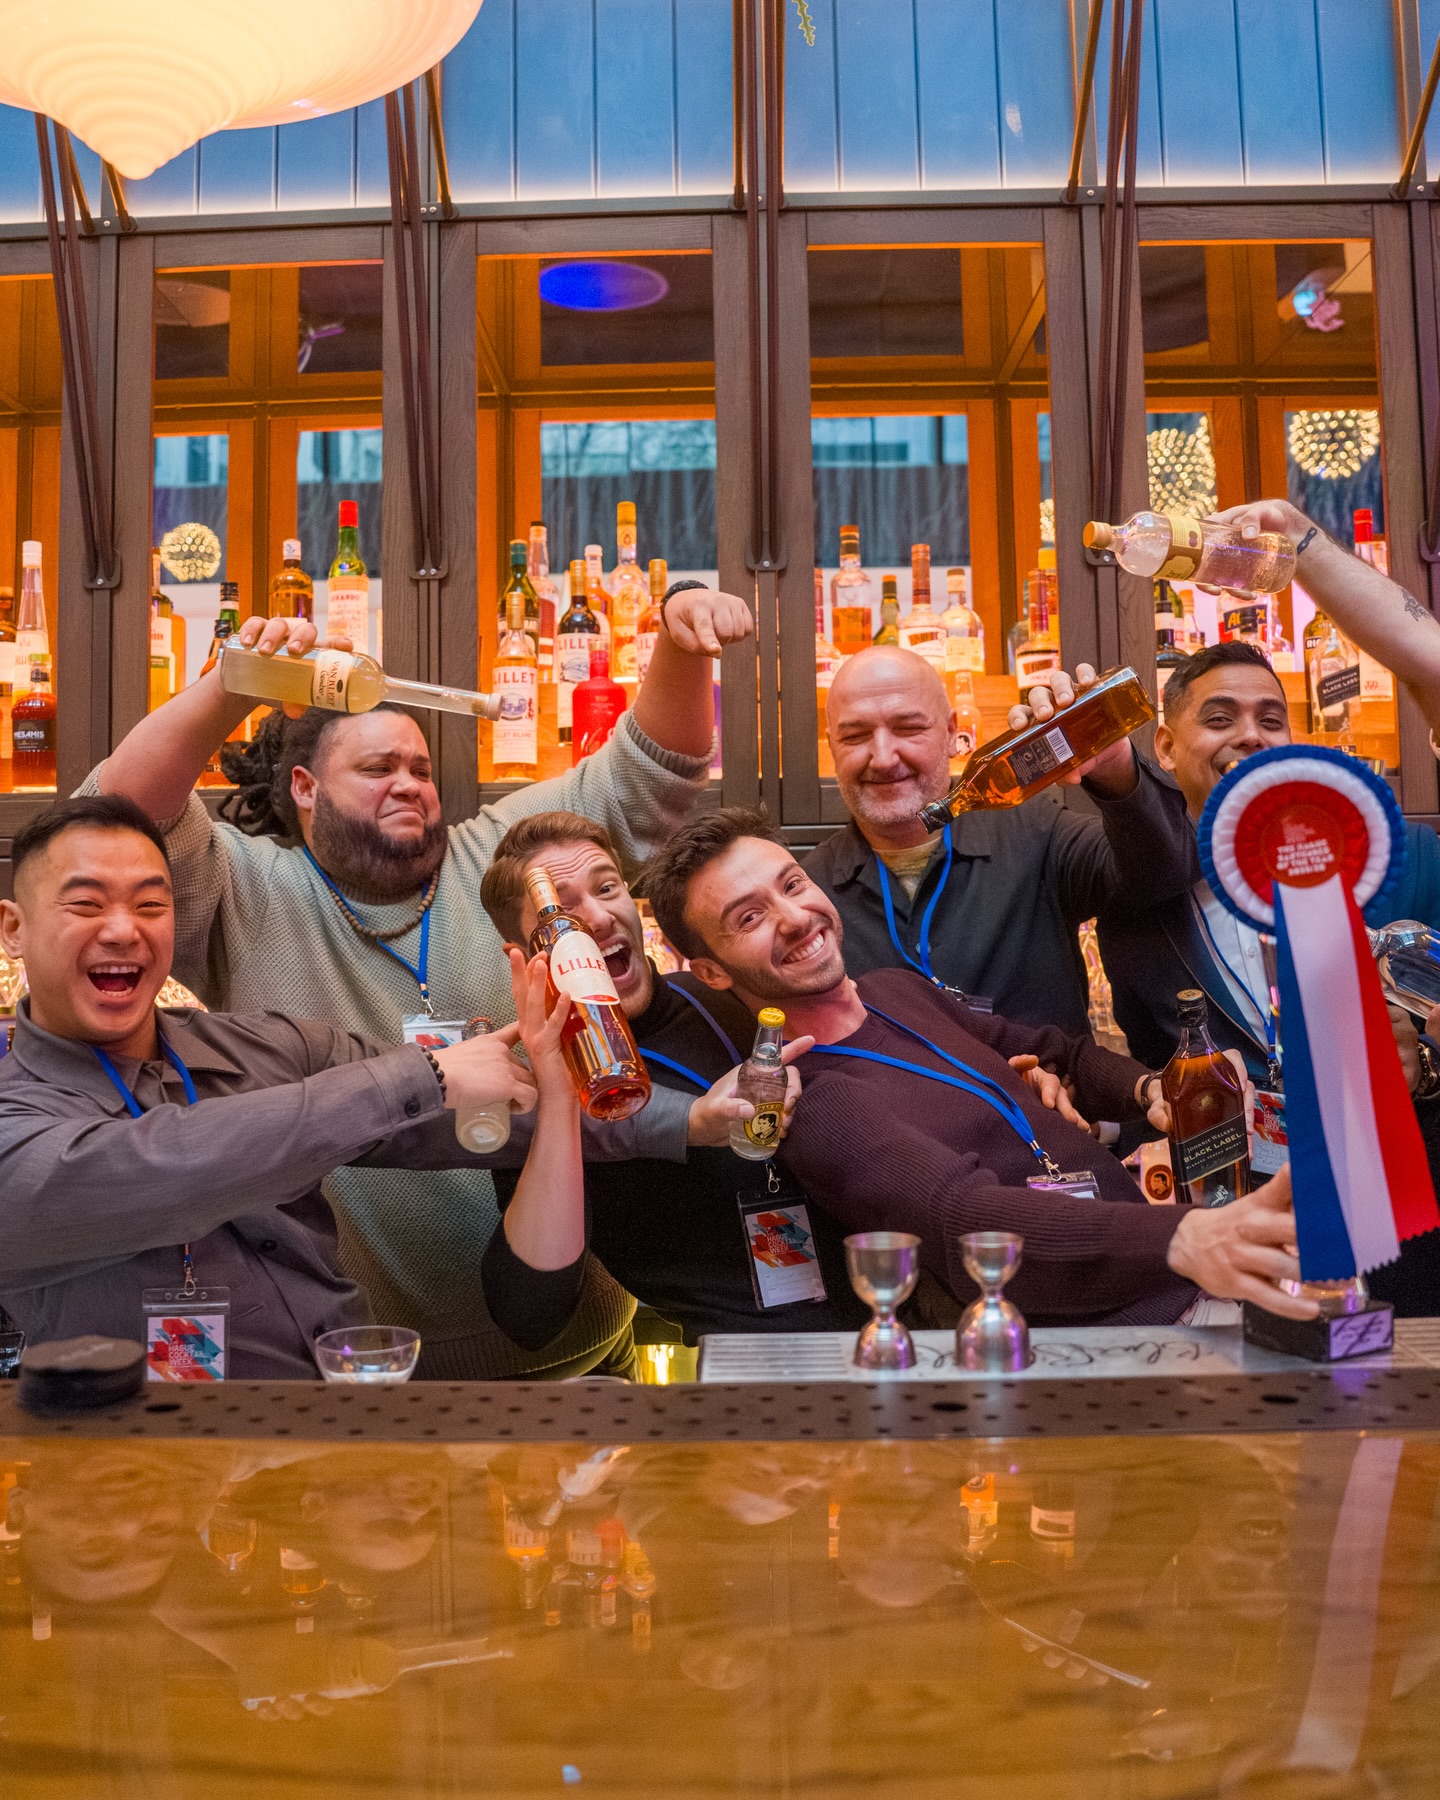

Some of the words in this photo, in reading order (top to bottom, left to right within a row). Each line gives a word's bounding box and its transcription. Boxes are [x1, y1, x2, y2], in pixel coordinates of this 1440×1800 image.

[330, 660, 340, 679] VAN
[1322, 683, 1342, 695] BLACK
[1342, 677, 1358, 688] LABE
[213, 764, 221, 772] 12
[1183, 1146, 1212, 1163] BLACK
[1213, 1132, 1242, 1149] LABEL
[1187, 1138, 1211, 1154] JOHNNIE
[1211, 1127, 1235, 1141] WALKER
[168, 1344, 196, 1352] HAGUE
[170, 1359, 193, 1367] WEEK
